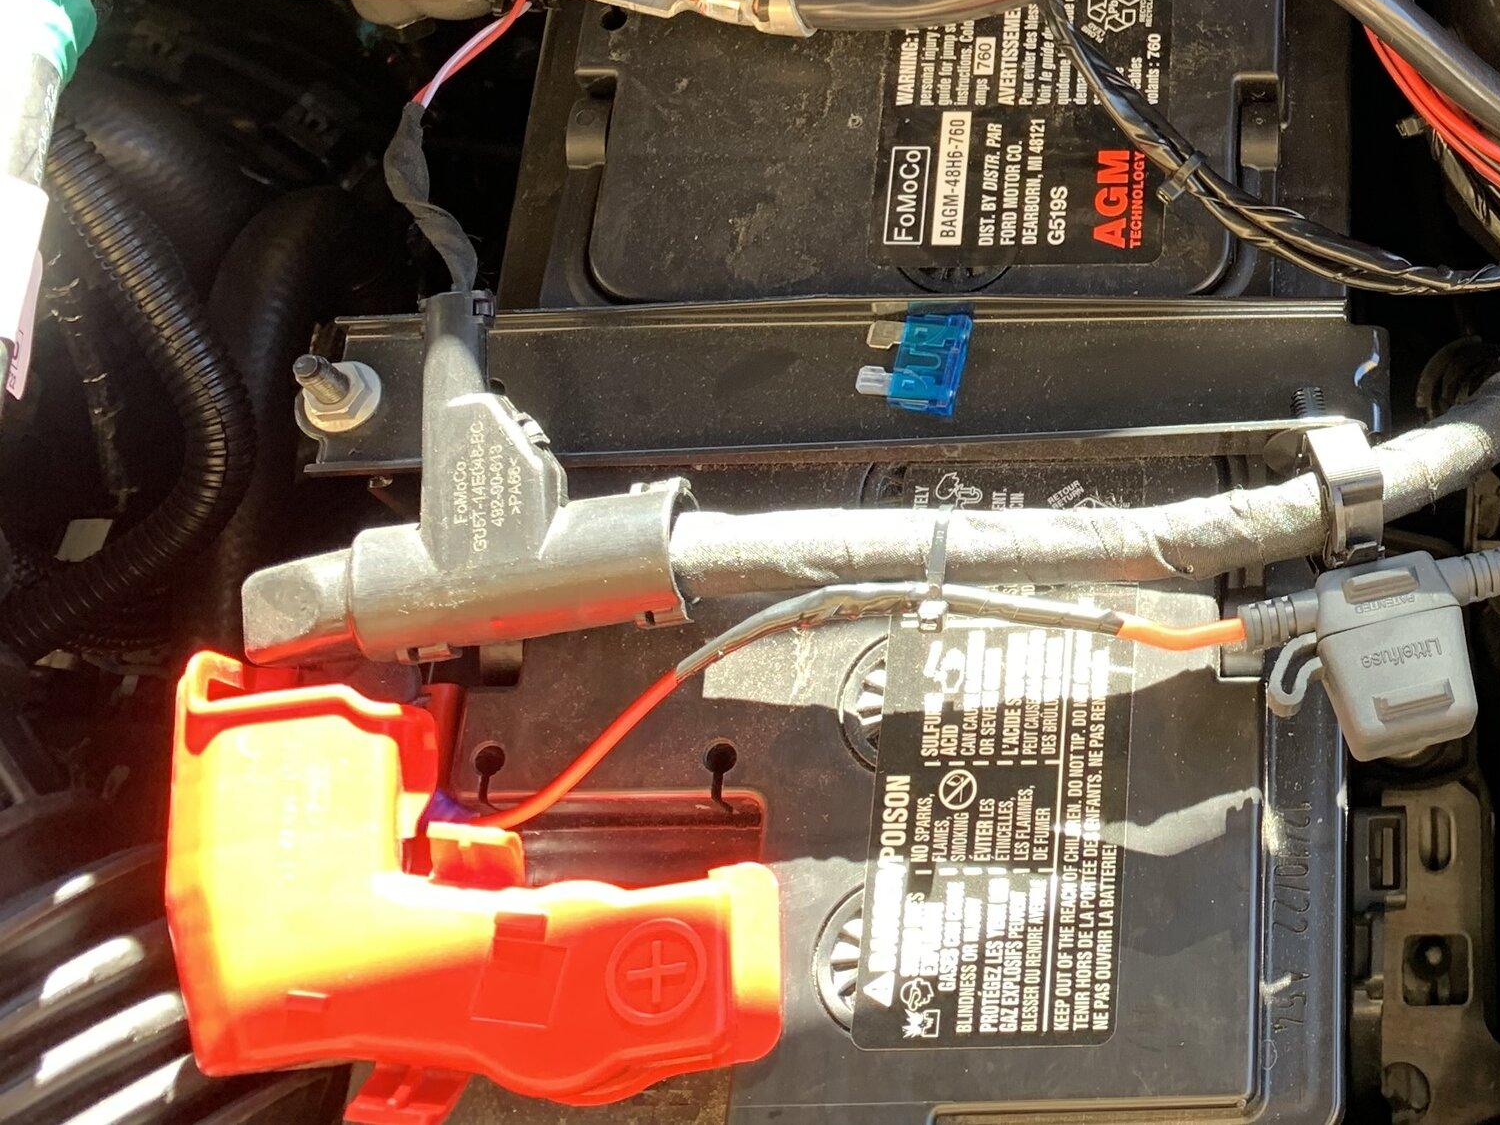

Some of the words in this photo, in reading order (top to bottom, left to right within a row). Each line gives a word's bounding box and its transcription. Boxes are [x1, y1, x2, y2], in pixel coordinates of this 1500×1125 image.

[923, 32, 938, 60] injury
[942, 35, 957, 60] jump
[1023, 32, 1037, 49] des
[1147, 34, 1161, 59] 760
[940, 62, 953, 76] for
[977, 43, 991, 69] 760
[998, 7, 1021, 105] AVERTISSEME
[1022, 52, 1036, 80] eviter
[1041, 41, 1055, 69] guide
[896, 38, 920, 105] WARNING:
[920, 63, 935, 105] personal
[954, 45, 973, 105] instructions.
[1039, 71, 1052, 81] le
[938, 78, 953, 105] guide
[975, 79, 990, 105] amps
[1019, 82, 1033, 105] Pour
[1037, 84, 1052, 105] Voir
[1145, 69, 1159, 105] volants
[986, 124, 1002, 147] PAR
[1030, 119, 1045, 153] 48121
[1007, 141, 1022, 161] CO.
[1027, 156, 1042, 170] MI
[940, 119, 965, 238] BAGM-48H6-760
[982, 152, 1000, 191] DISTR.
[893, 150, 921, 241] FoMoCo
[1003, 164, 1020, 208] MOTOR
[1093, 150, 1129, 248] AGM
[1130, 151, 1145, 248] TECHNOLOGY
[981, 195, 997, 211] BY
[1022, 175, 1044, 244] DEARBORN,
[1047, 186, 1068, 245] G519S
[979, 215, 996, 245] DIST.
[1000, 212, 1017, 245] FORD
[453, 461, 468, 524] FoMoCo
[1355, 594, 1415, 614] PATENTED
[1361, 637, 1442, 668] Littelfuse
[1001, 709, 1021, 755] L'ACIDE
[1072, 710, 1087, 726] DO
[940, 724, 958, 756] ACID
[961, 733, 977, 756] CAN
[979, 738, 995, 755] OR
[1021, 731, 1038, 755] PEUT
[1041, 735, 1057, 755] DES
[1070, 730, 1085, 751] TIP.
[1088, 724, 1105, 747] PAS
[1069, 754, 1084, 777] NOT
[1088, 750, 1103, 767] NE
[1068, 780, 1083, 796] DO
[1084, 770, 1102, 834] NFANTS.
[914, 794, 935, 841] SPARKS,
[979, 798, 995, 817] LES
[1016, 785, 1035, 839] FLAMMES,
[934, 816, 951, 862] FLAMES,
[951, 812, 969, 862] SMOKING
[991, 797, 1016, 861] ÉTINCELLES,
[1034, 808, 1050, 844] FUMER
[1064, 801, 1083, 862] CHILREN.
[911, 846, 929, 862] NO
[969, 821, 993, 861] ÉVITER
[1013, 842, 1030, 861] LES
[1033, 847, 1048, 860] DE
[1062, 865, 1079, 881] OF
[1079, 858, 1097, 909] PORTÉE
[1100, 845, 1117, 908] BATTERIE!
[1080, 912, 1095, 928] LA
[1098, 911, 1114, 927] LA
[1026, 927, 1043, 966] RENDRE
[1058, 927, 1075, 948] THE
[1079, 931, 1094, 948] DE
[962, 945, 978, 962] OR
[985, 941, 1003, 963] LES
[1057, 952, 1072, 969] OF
[1095, 930, 1113, 979] OUVRIR
[1002, 941, 1023, 1005] EXPLOSIFS
[1024, 969, 1040, 983] OU
[1056, 972, 1071, 995] OUT
[1076, 951, 1093, 988] HORS
[957, 965, 977, 1032] BLINDNESS
[979, 966, 1001, 1032] PROTÉGEZ
[1022, 986, 1039, 1031] BLESSER
[1094, 983, 1111, 1009] PAS
[1000, 1008, 1018, 1032] GAZ
[1054, 1000, 1070, 1030] KEEP
[1073, 991, 1091, 1030] TENIR
[1093, 1012, 1109, 1030] NE
